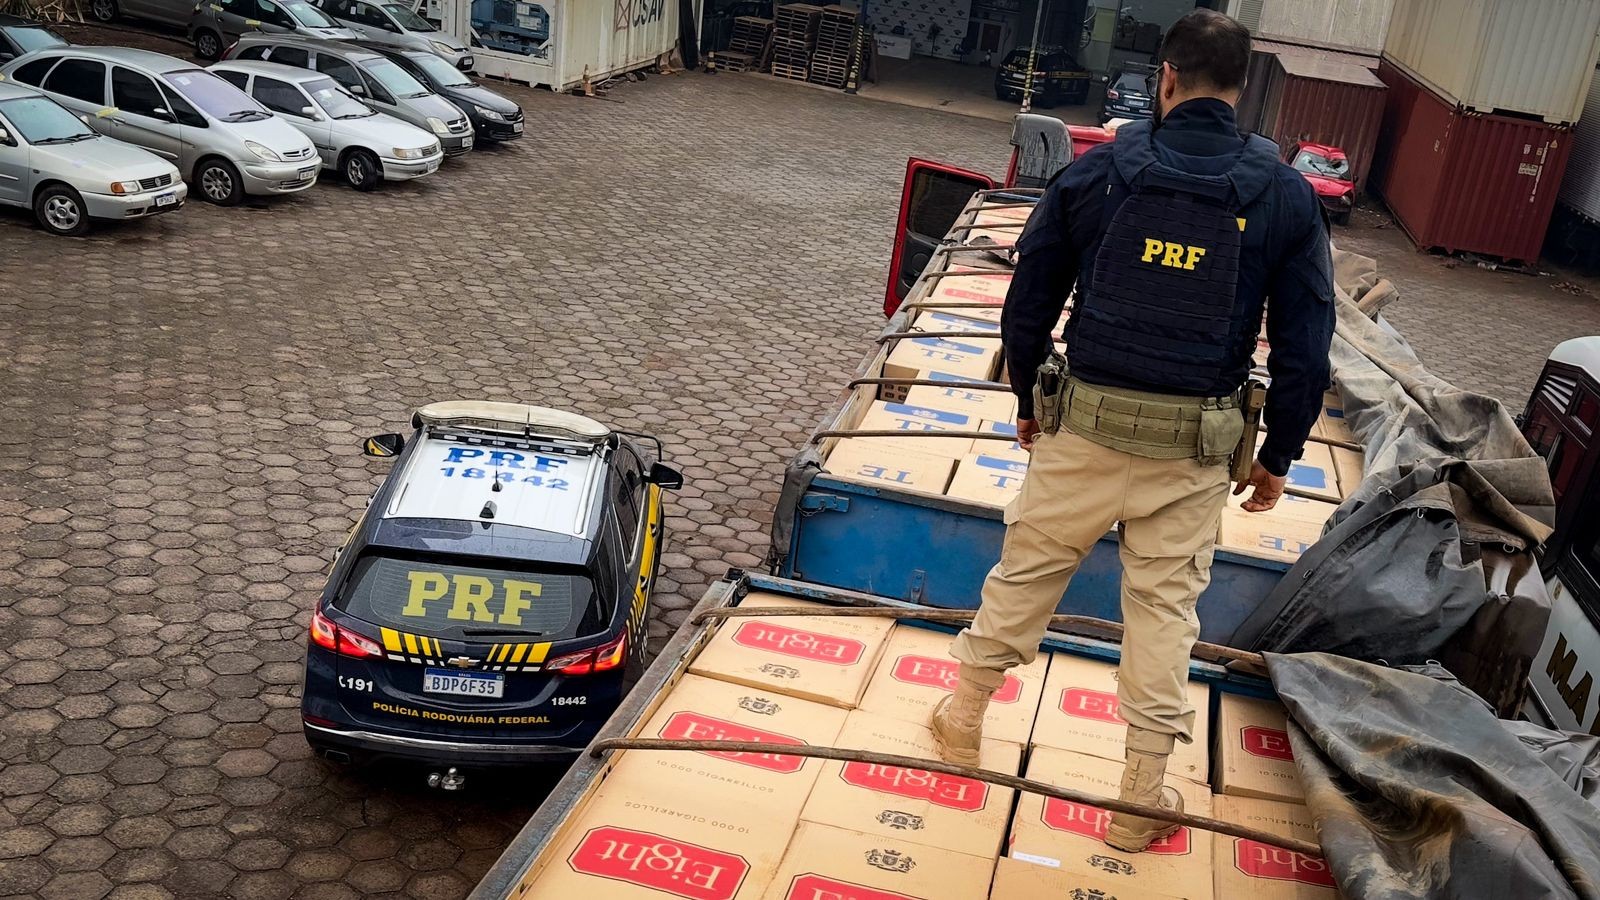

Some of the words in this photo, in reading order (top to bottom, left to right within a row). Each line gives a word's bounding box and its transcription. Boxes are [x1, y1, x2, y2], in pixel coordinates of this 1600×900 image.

[1012, 55, 1028, 65] PR
[1141, 238, 1206, 271] PRF
[442, 447, 568, 473] PRF
[440, 467, 569, 490] 18442
[402, 570, 543, 626] PRF
[752, 628, 849, 659] Eight
[346, 677, 373, 692] 191
[432, 676, 496, 694] BDP6F35
[551, 696, 587, 706] 18442
[372, 702, 419, 717] POLÍCIA
[422, 710, 495, 724] RODOVIÁRIA
[498, 716, 551, 724] FEDERAL
[595, 839, 728, 891] Eight
